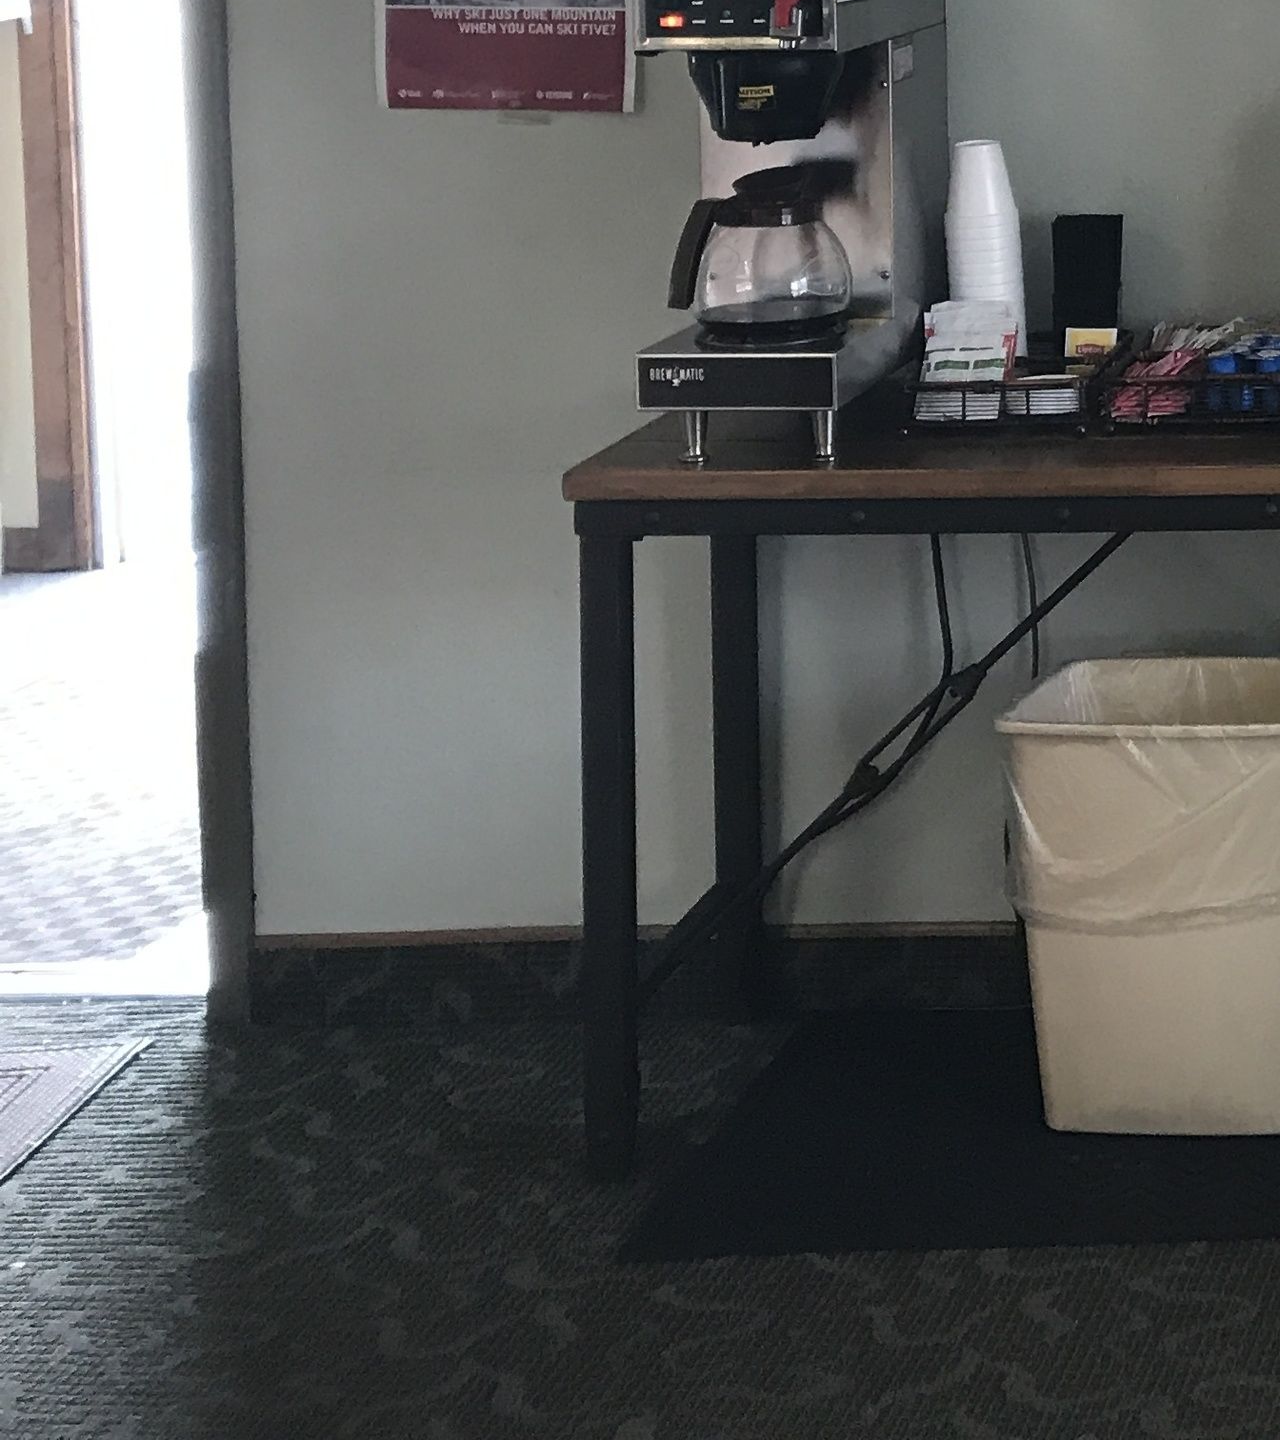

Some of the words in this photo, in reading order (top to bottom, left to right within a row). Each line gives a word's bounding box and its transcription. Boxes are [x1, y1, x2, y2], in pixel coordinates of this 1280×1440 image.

[432, 9, 461, 21] WHY
[465, 9, 486, 21] SKI
[489, 9, 519, 21] JUST
[523, 10, 547, 21] ONE
[551, 10, 616, 22] MOUNTAIN
[459, 22, 496, 35] WHEN
[501, 23, 525, 35] YOU
[528, 23, 553, 35] CAN
[557, 24, 578, 35] SKI
[581, 24, 616, 36] FIVE?
